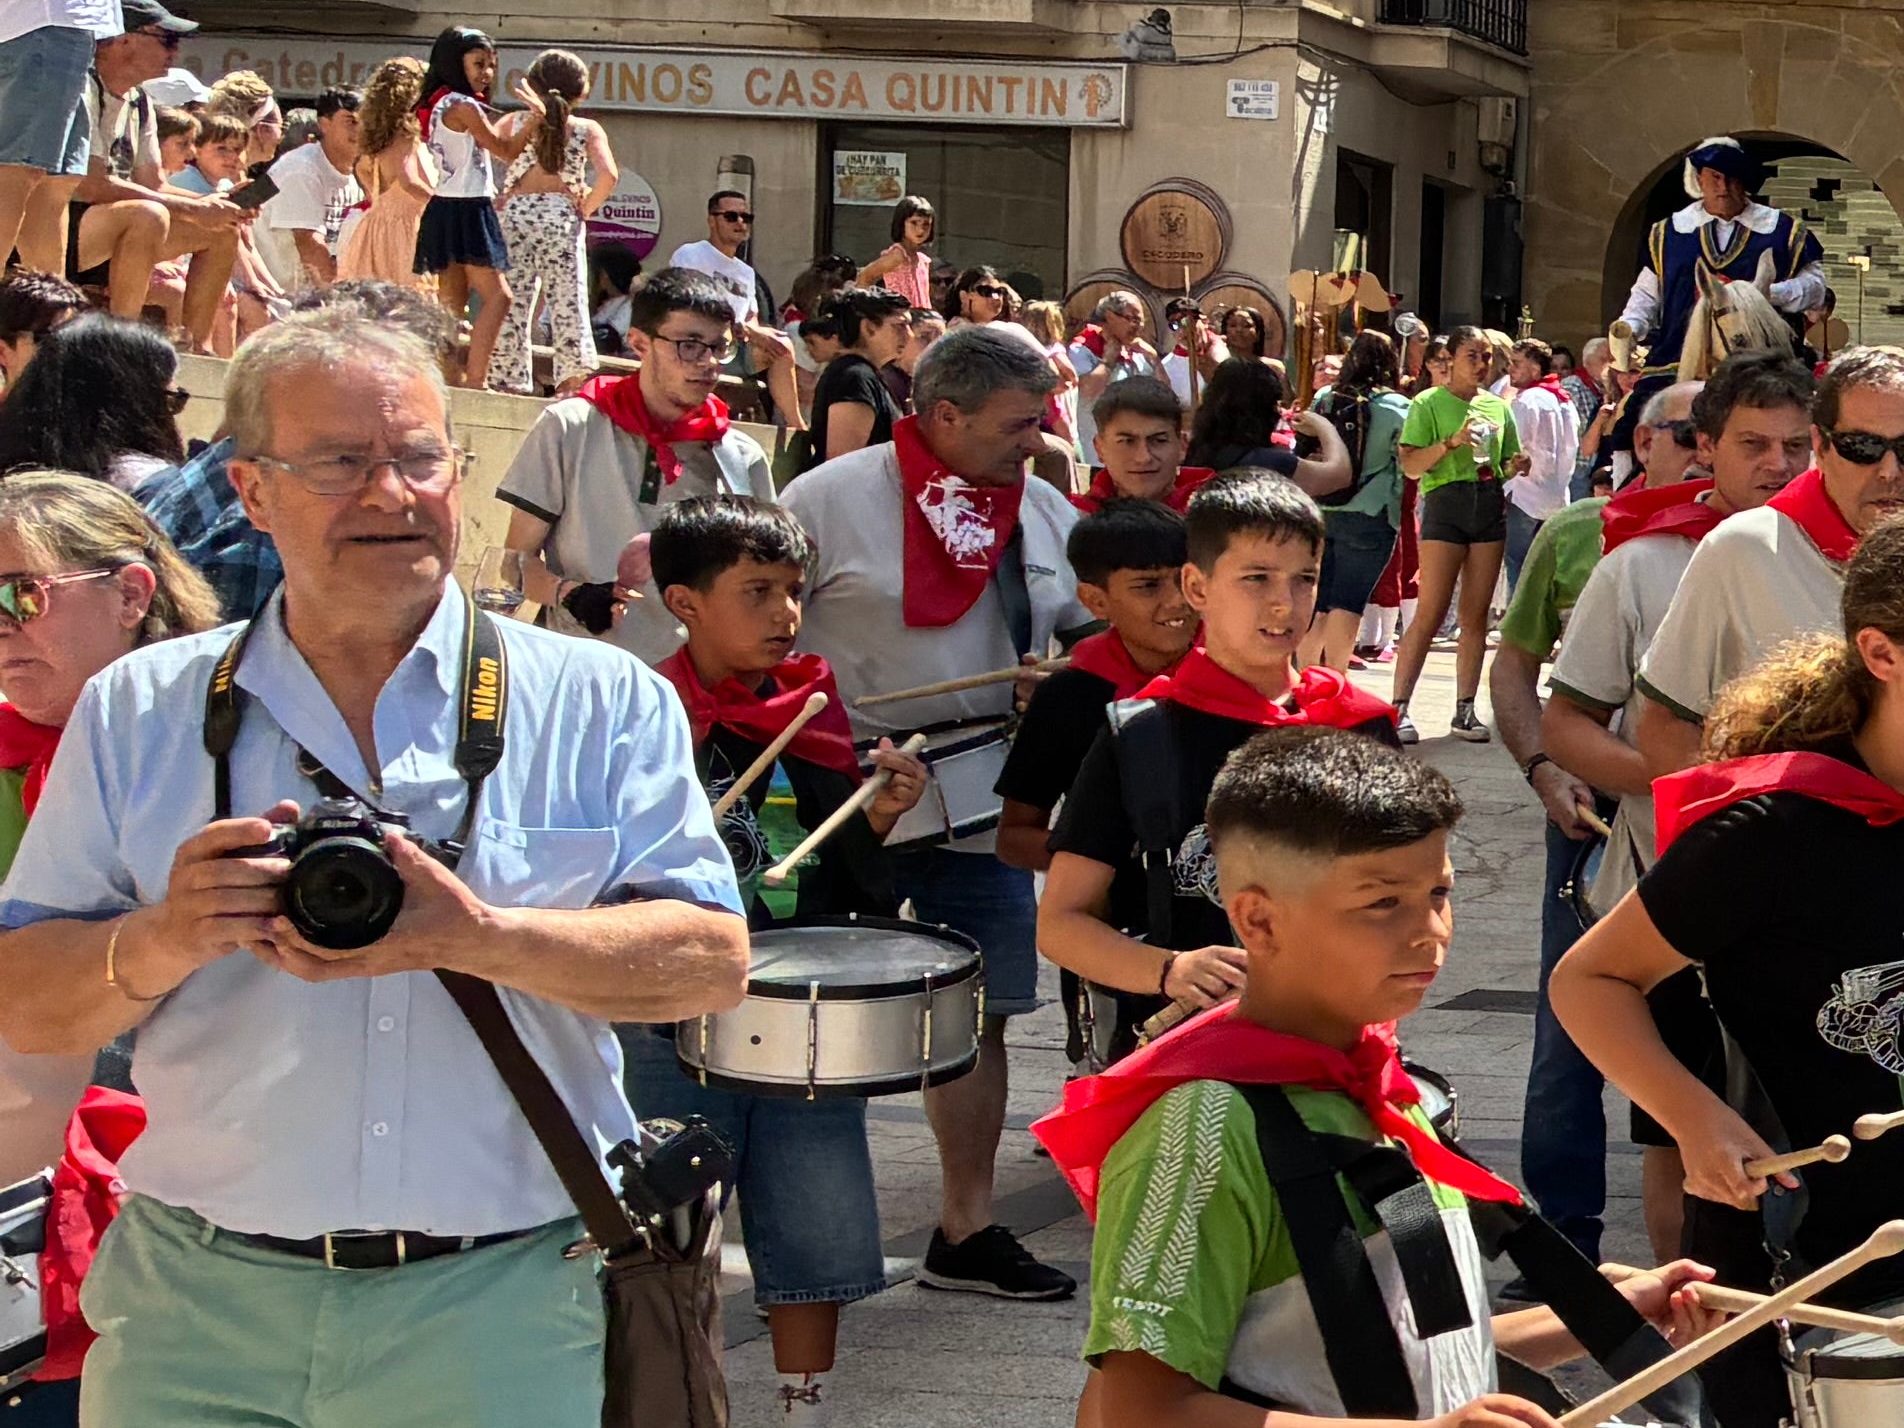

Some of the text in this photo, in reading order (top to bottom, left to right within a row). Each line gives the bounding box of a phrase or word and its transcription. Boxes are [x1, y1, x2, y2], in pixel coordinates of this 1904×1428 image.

[222, 47, 372, 90] Catedr
[744, 68, 869, 110] CASA
[885, 72, 1068, 118] QUINTIN
[602, 205, 655, 220] Quintin
[472, 656, 499, 721] Nikon
